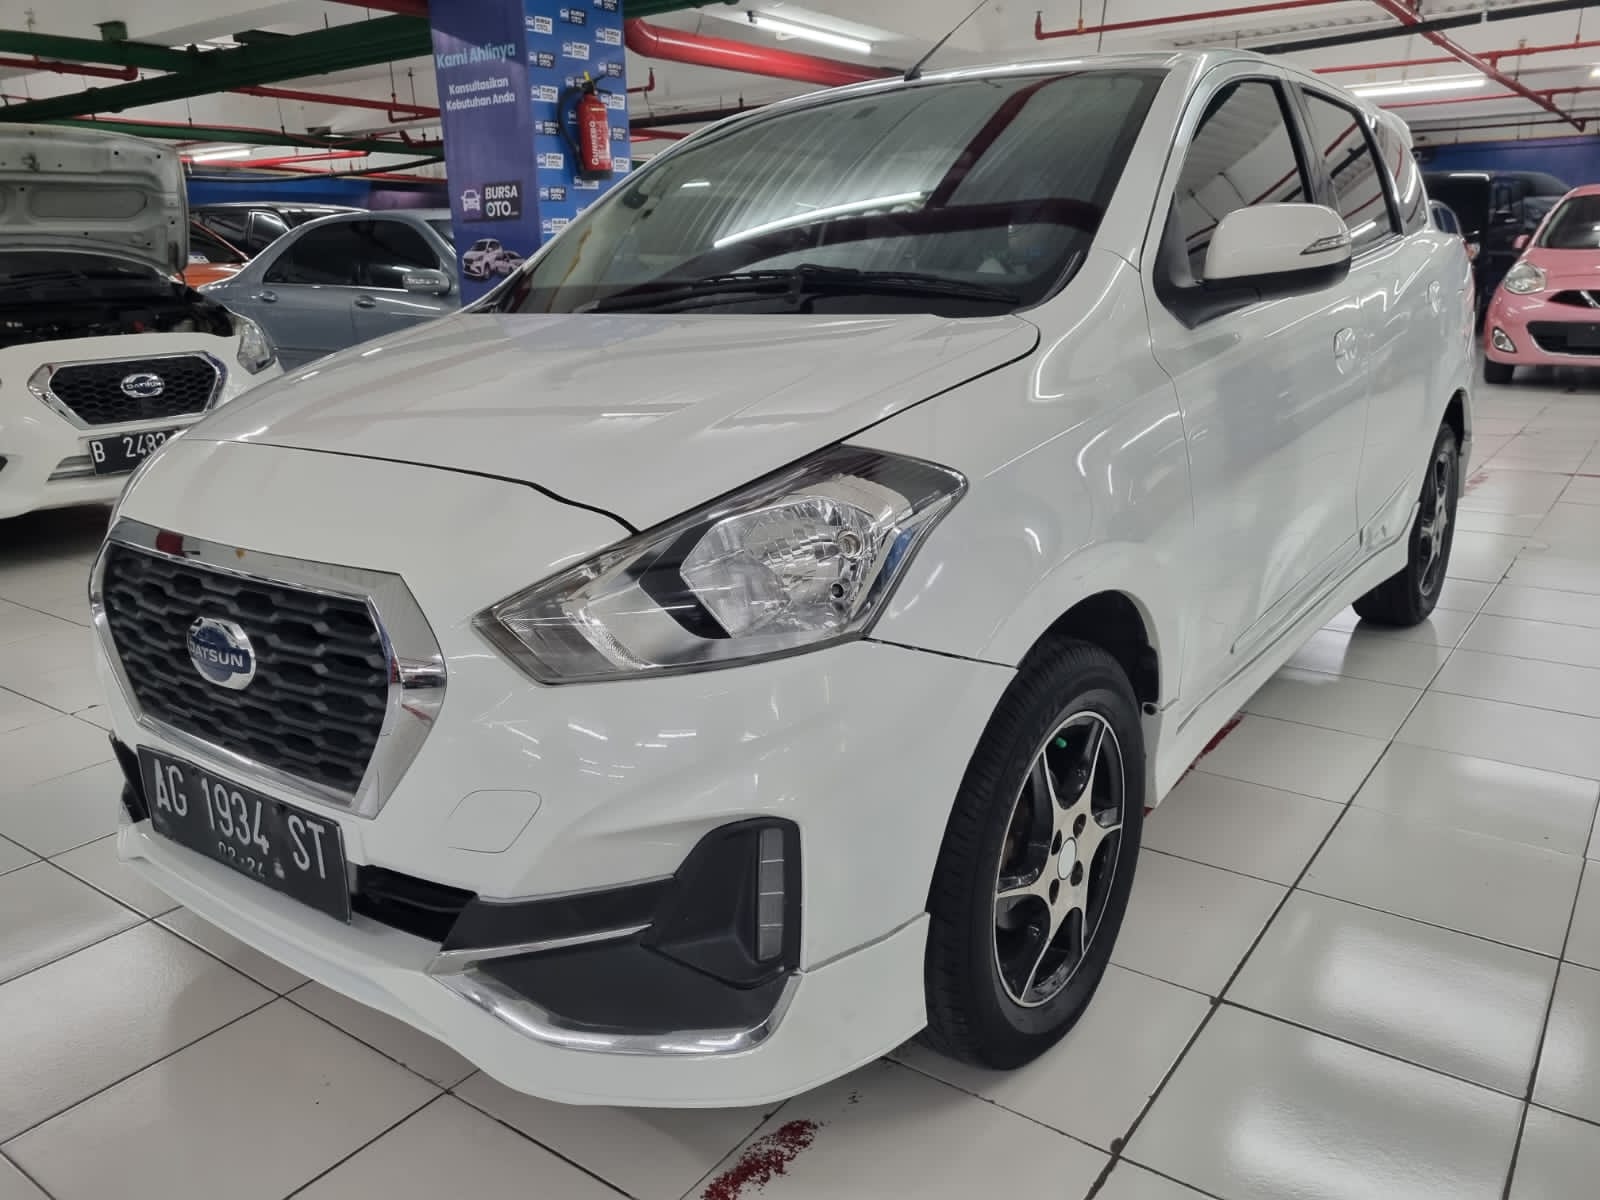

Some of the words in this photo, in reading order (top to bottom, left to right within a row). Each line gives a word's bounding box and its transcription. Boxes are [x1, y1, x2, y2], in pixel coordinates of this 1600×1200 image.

[436, 46, 468, 70] Kami
[469, 42, 515, 64] Ahlinya
[493, 91, 515, 105] Anda
[485, 184, 519, 200] BURSA
[486, 200, 512, 217] OTO
[91, 441, 106, 463] B
[189, 640, 244, 668] DATSUN
[154, 758, 188, 817] AG
[201, 777, 270, 856] 1934
[287, 814, 326, 880] ST
